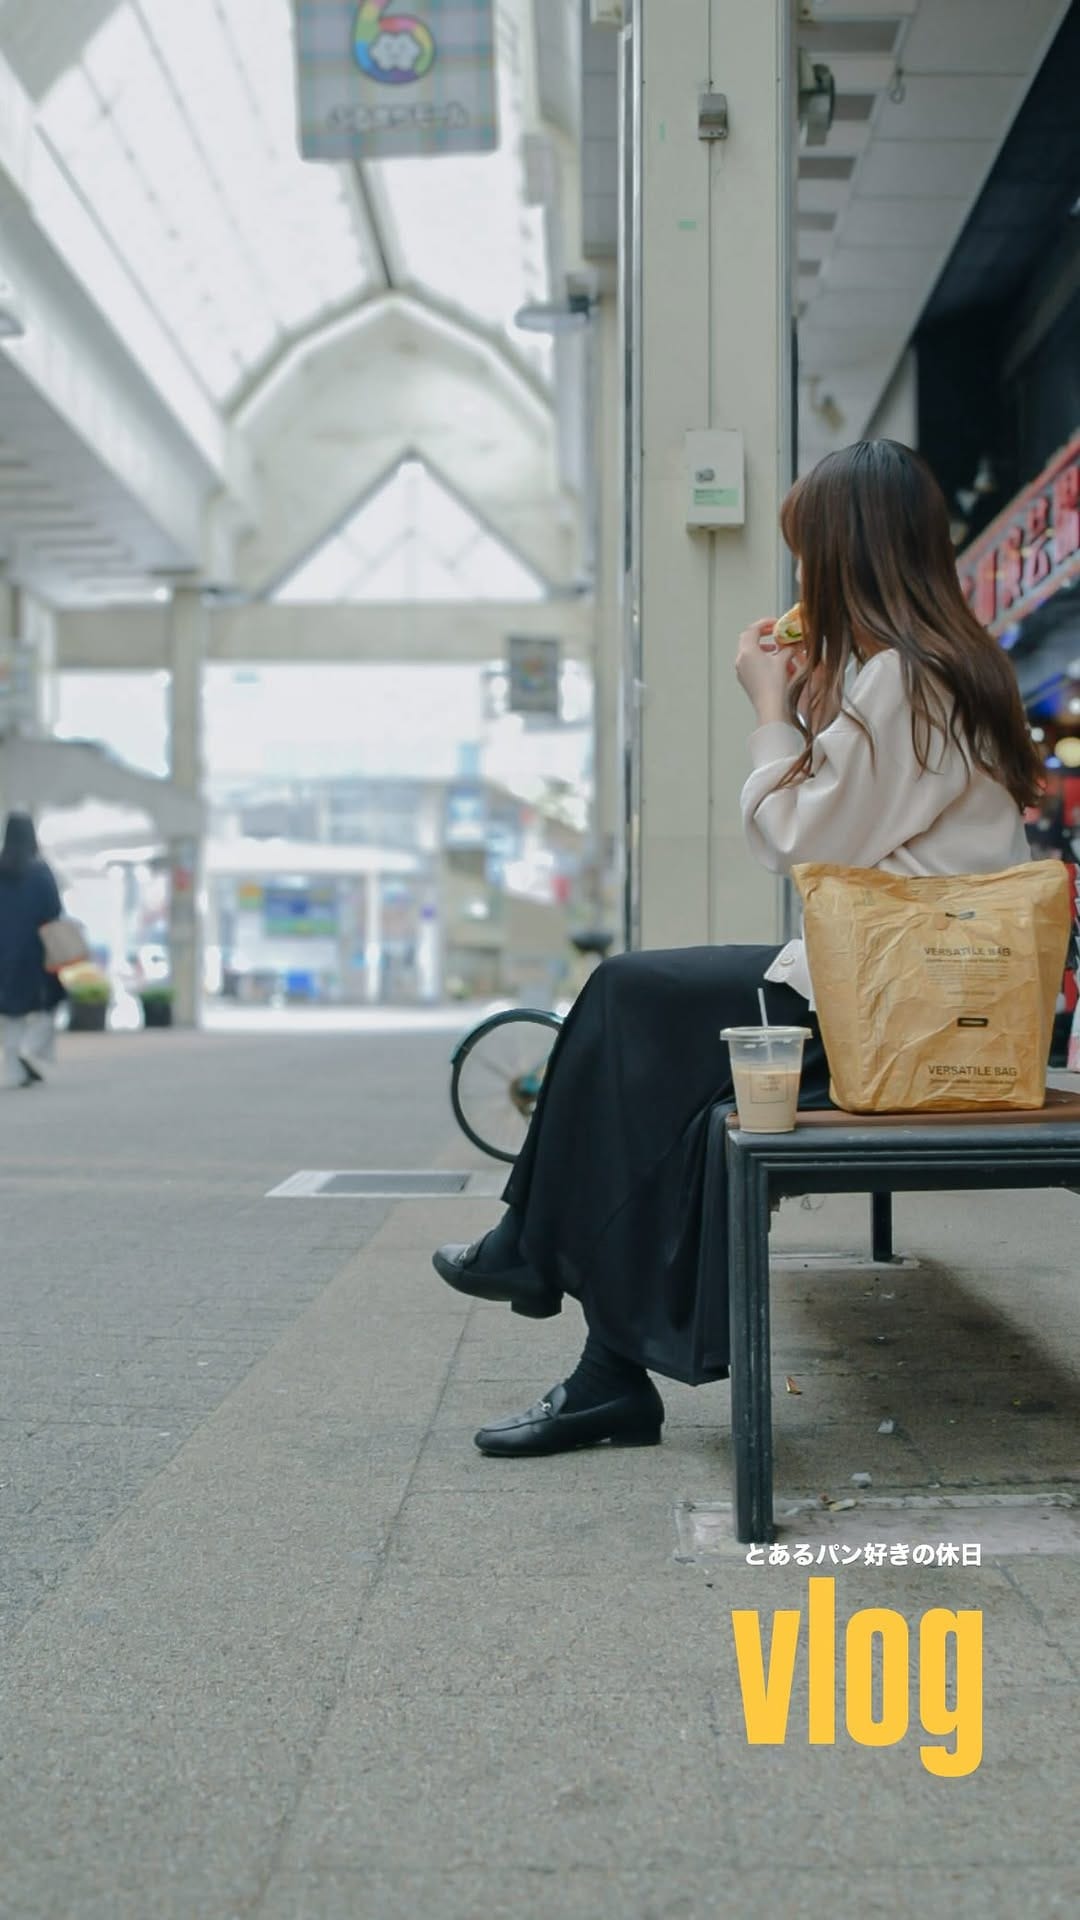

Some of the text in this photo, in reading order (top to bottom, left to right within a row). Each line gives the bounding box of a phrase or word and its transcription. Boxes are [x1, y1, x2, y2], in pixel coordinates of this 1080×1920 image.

[924, 947, 984, 955] VERSATILE
[928, 1065, 1018, 1077] VERSATILE BAG
